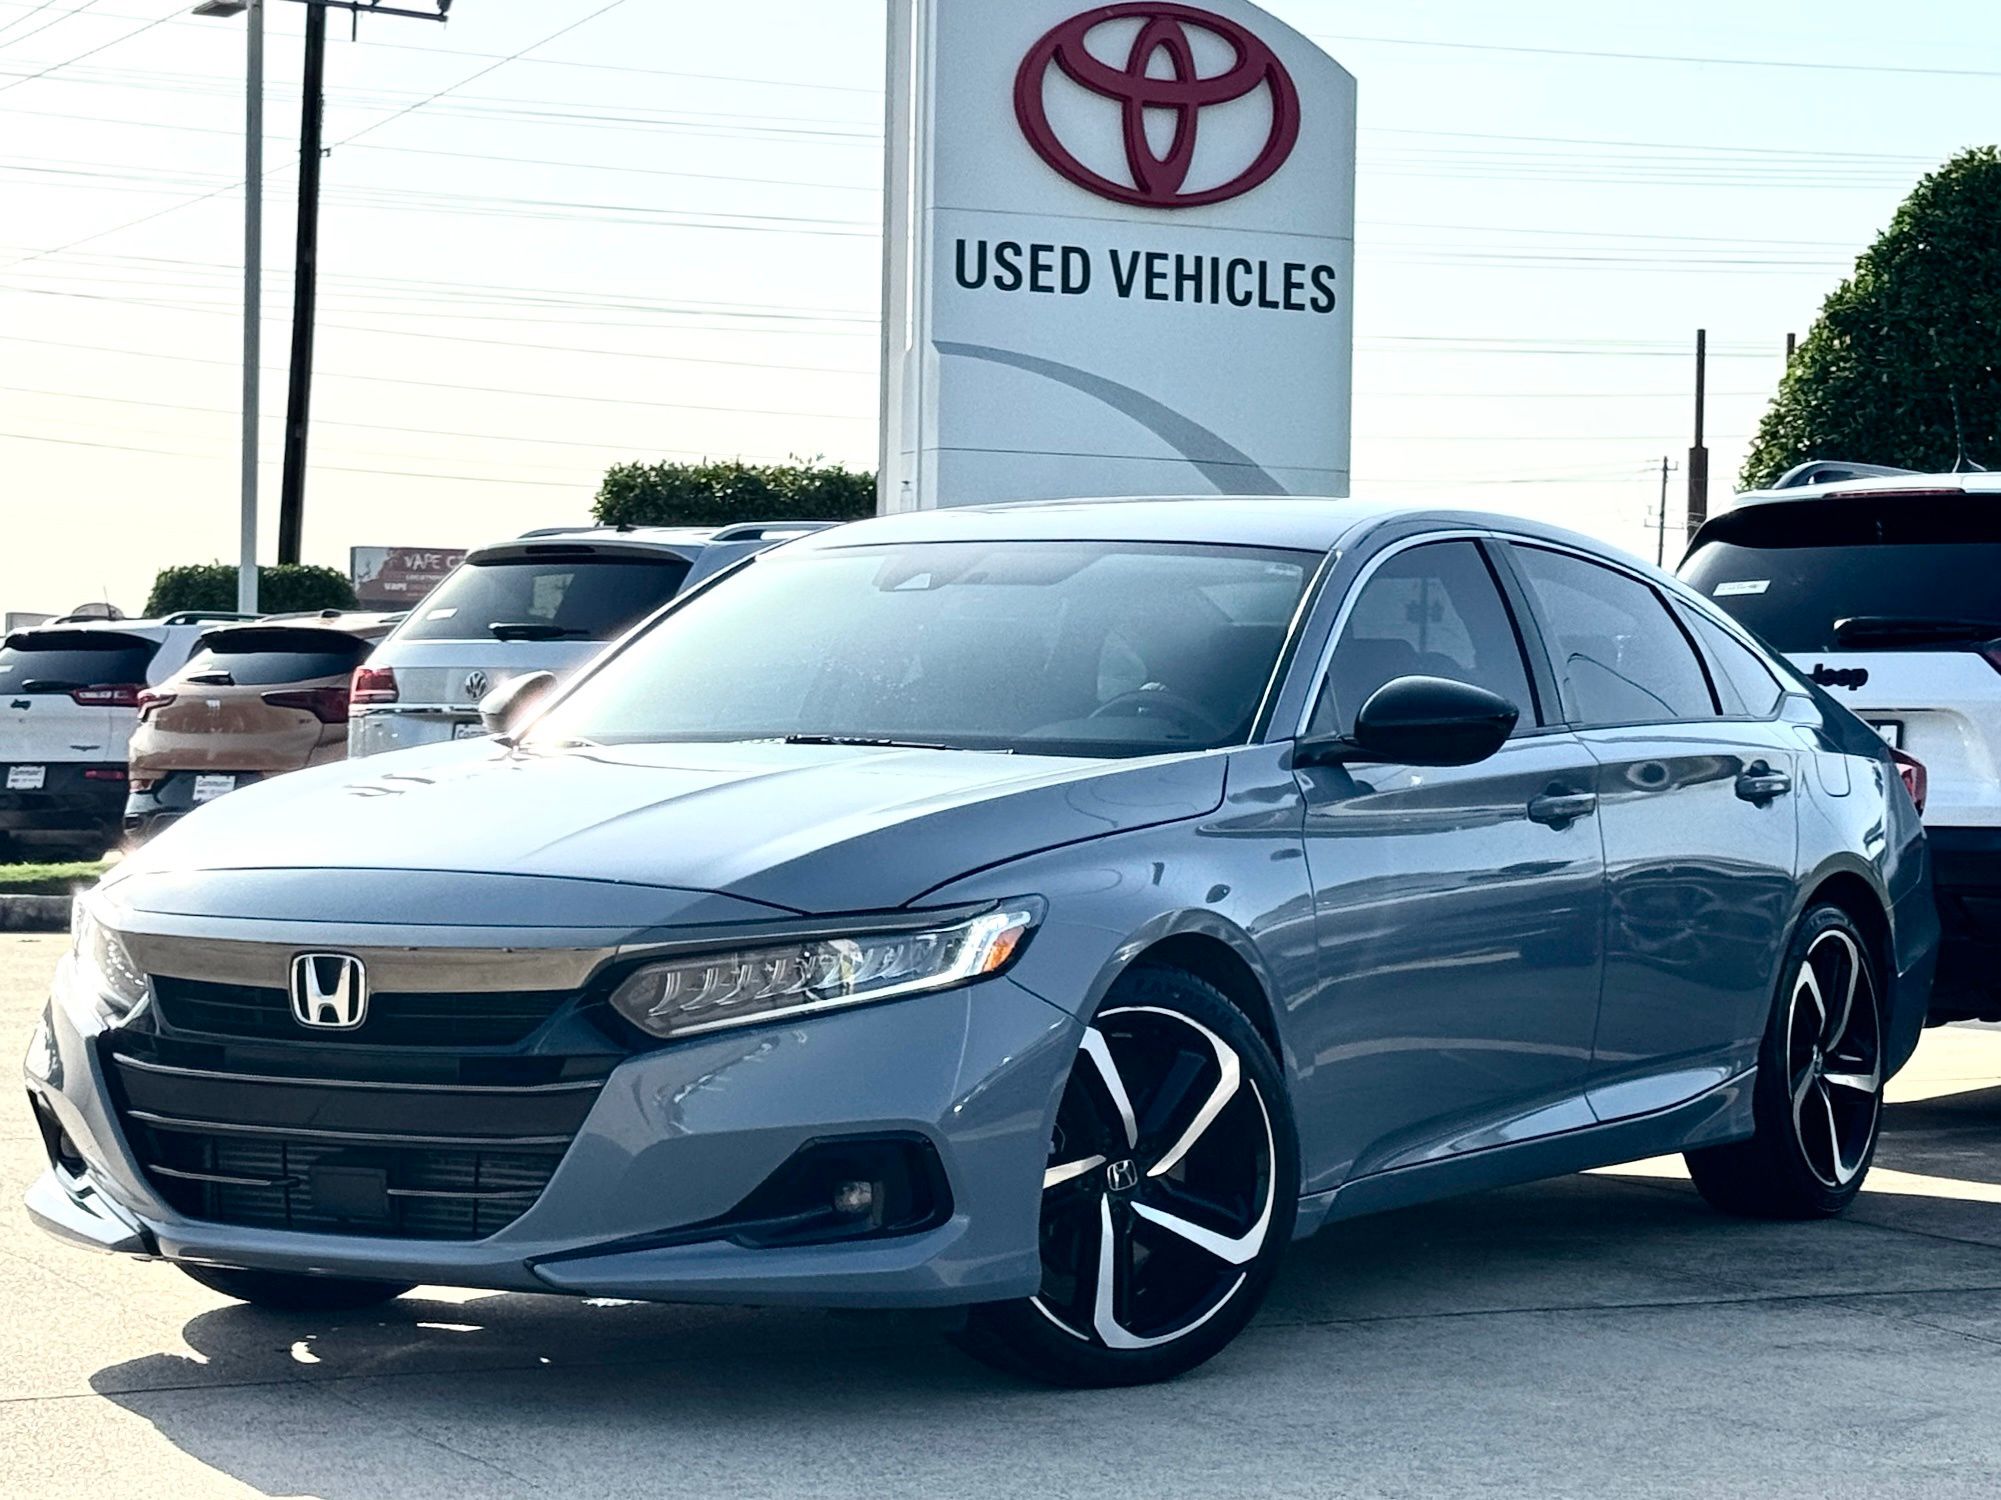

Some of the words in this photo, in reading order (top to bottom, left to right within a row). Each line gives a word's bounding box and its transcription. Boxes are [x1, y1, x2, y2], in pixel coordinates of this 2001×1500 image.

[955, 238, 1091, 295] USED
[1108, 249, 1336, 314] VEHICLES
[404, 554, 442, 570] VAPE
